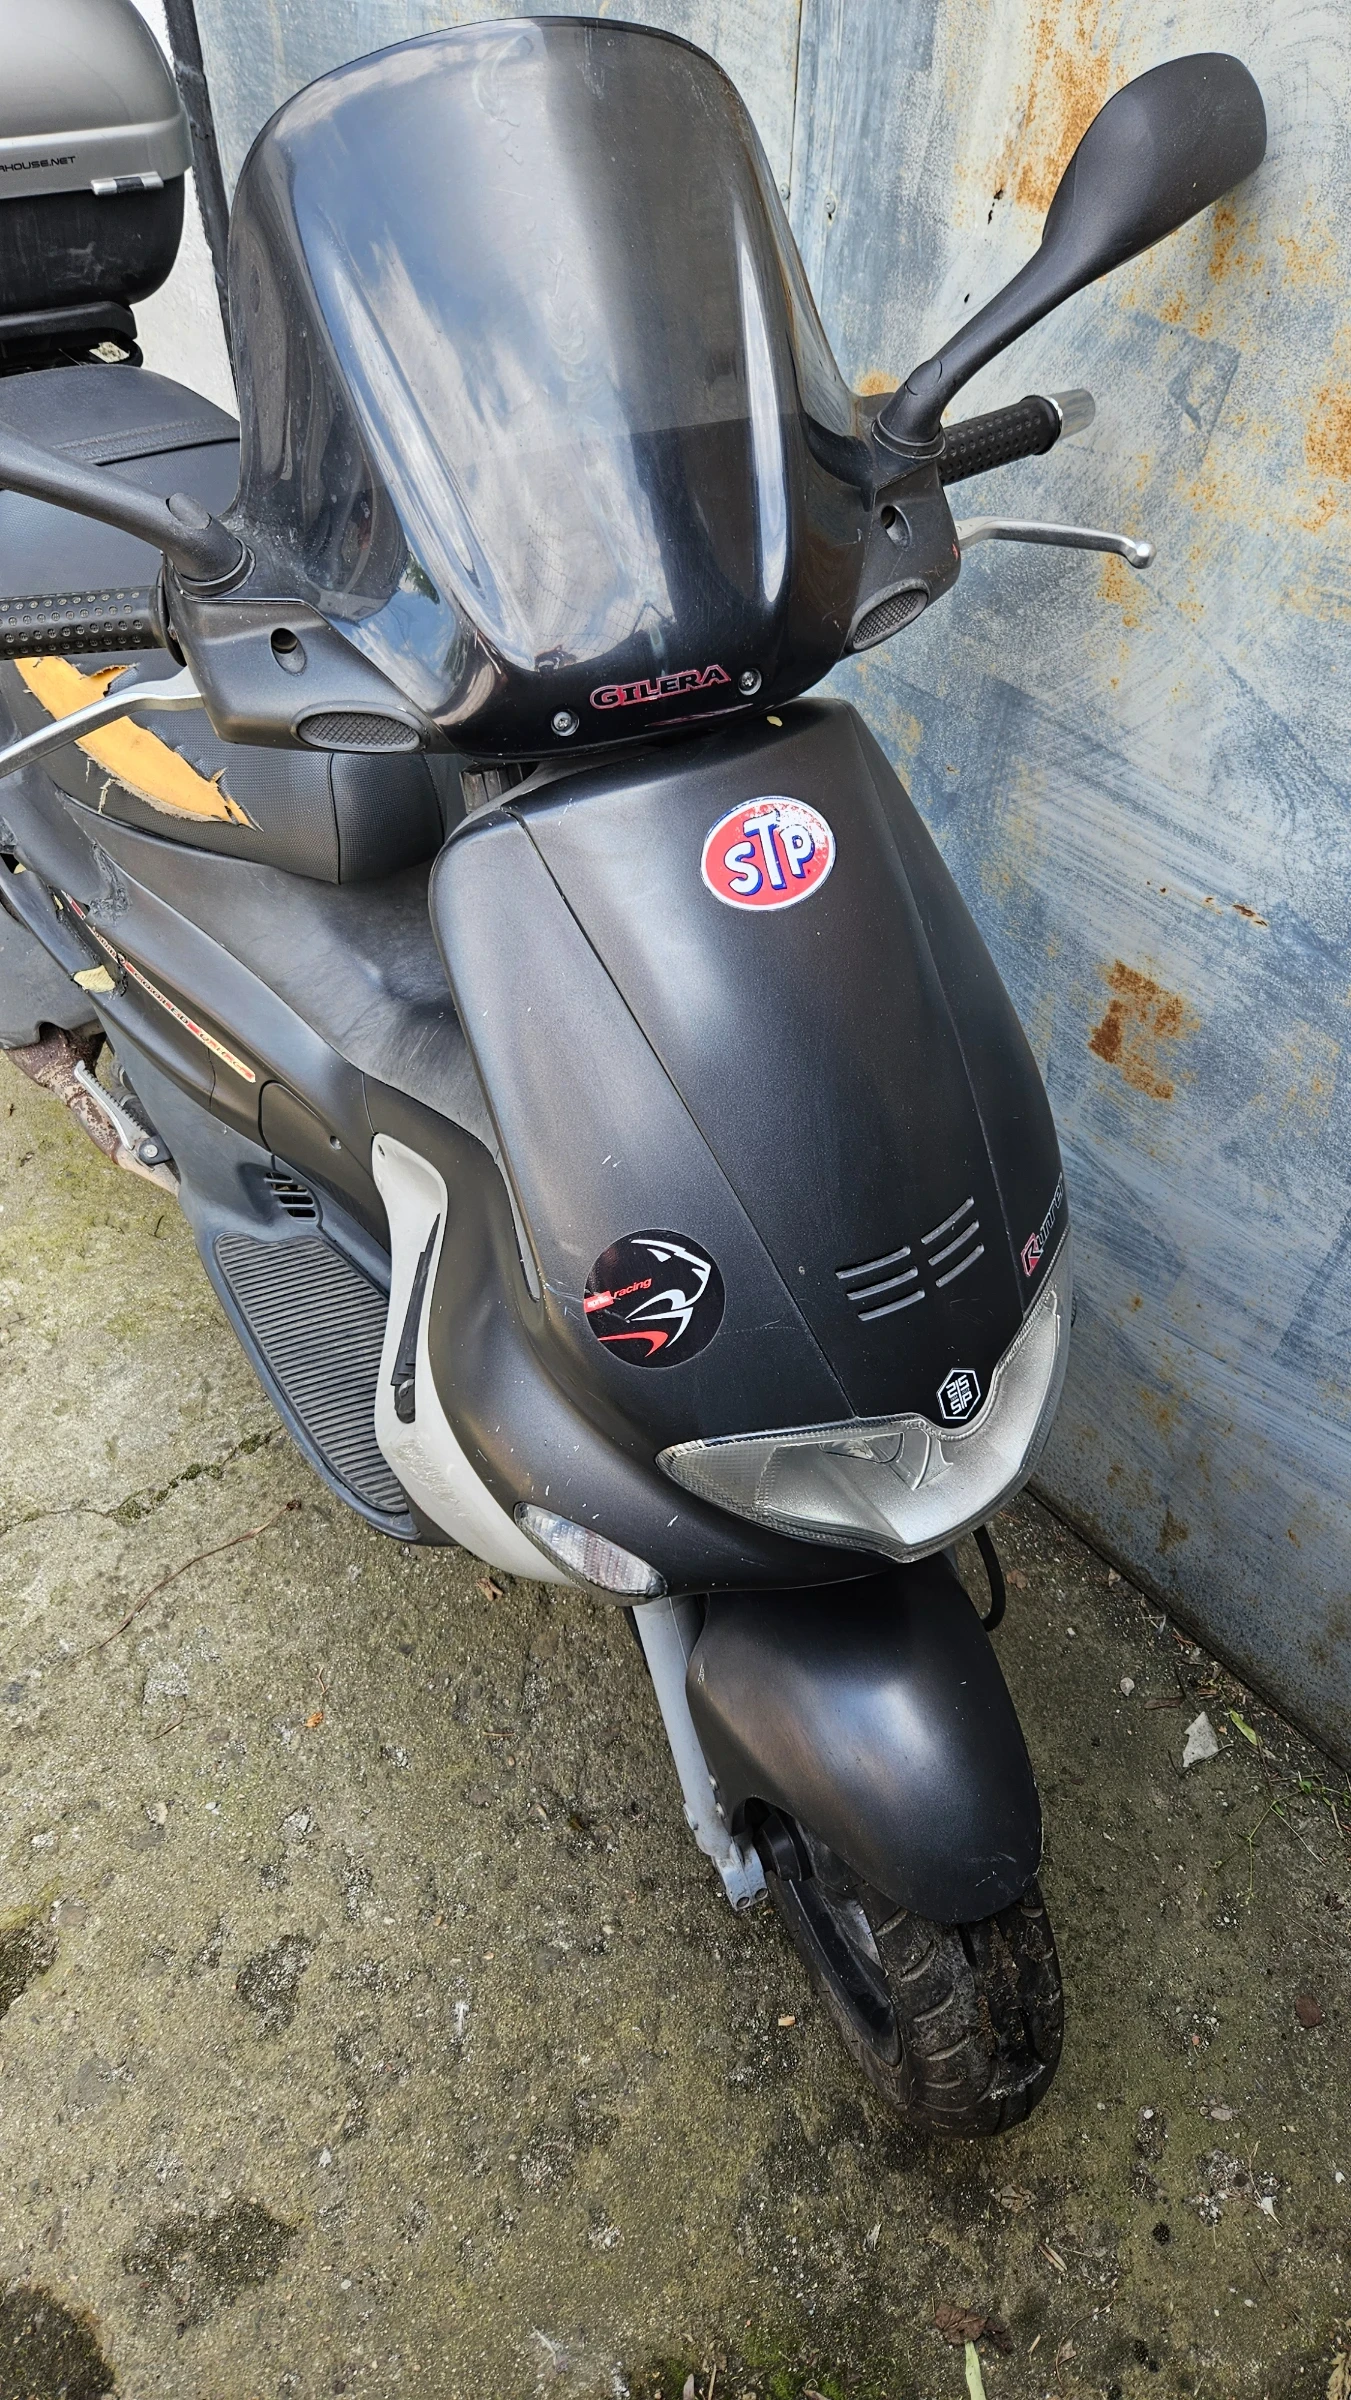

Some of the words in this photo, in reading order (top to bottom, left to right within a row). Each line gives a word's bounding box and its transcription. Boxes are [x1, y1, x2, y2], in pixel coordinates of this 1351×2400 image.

[590, 664, 731, 709] GILERA
[723, 808, 816, 896] STP
[613, 1278, 652, 1300] racing
